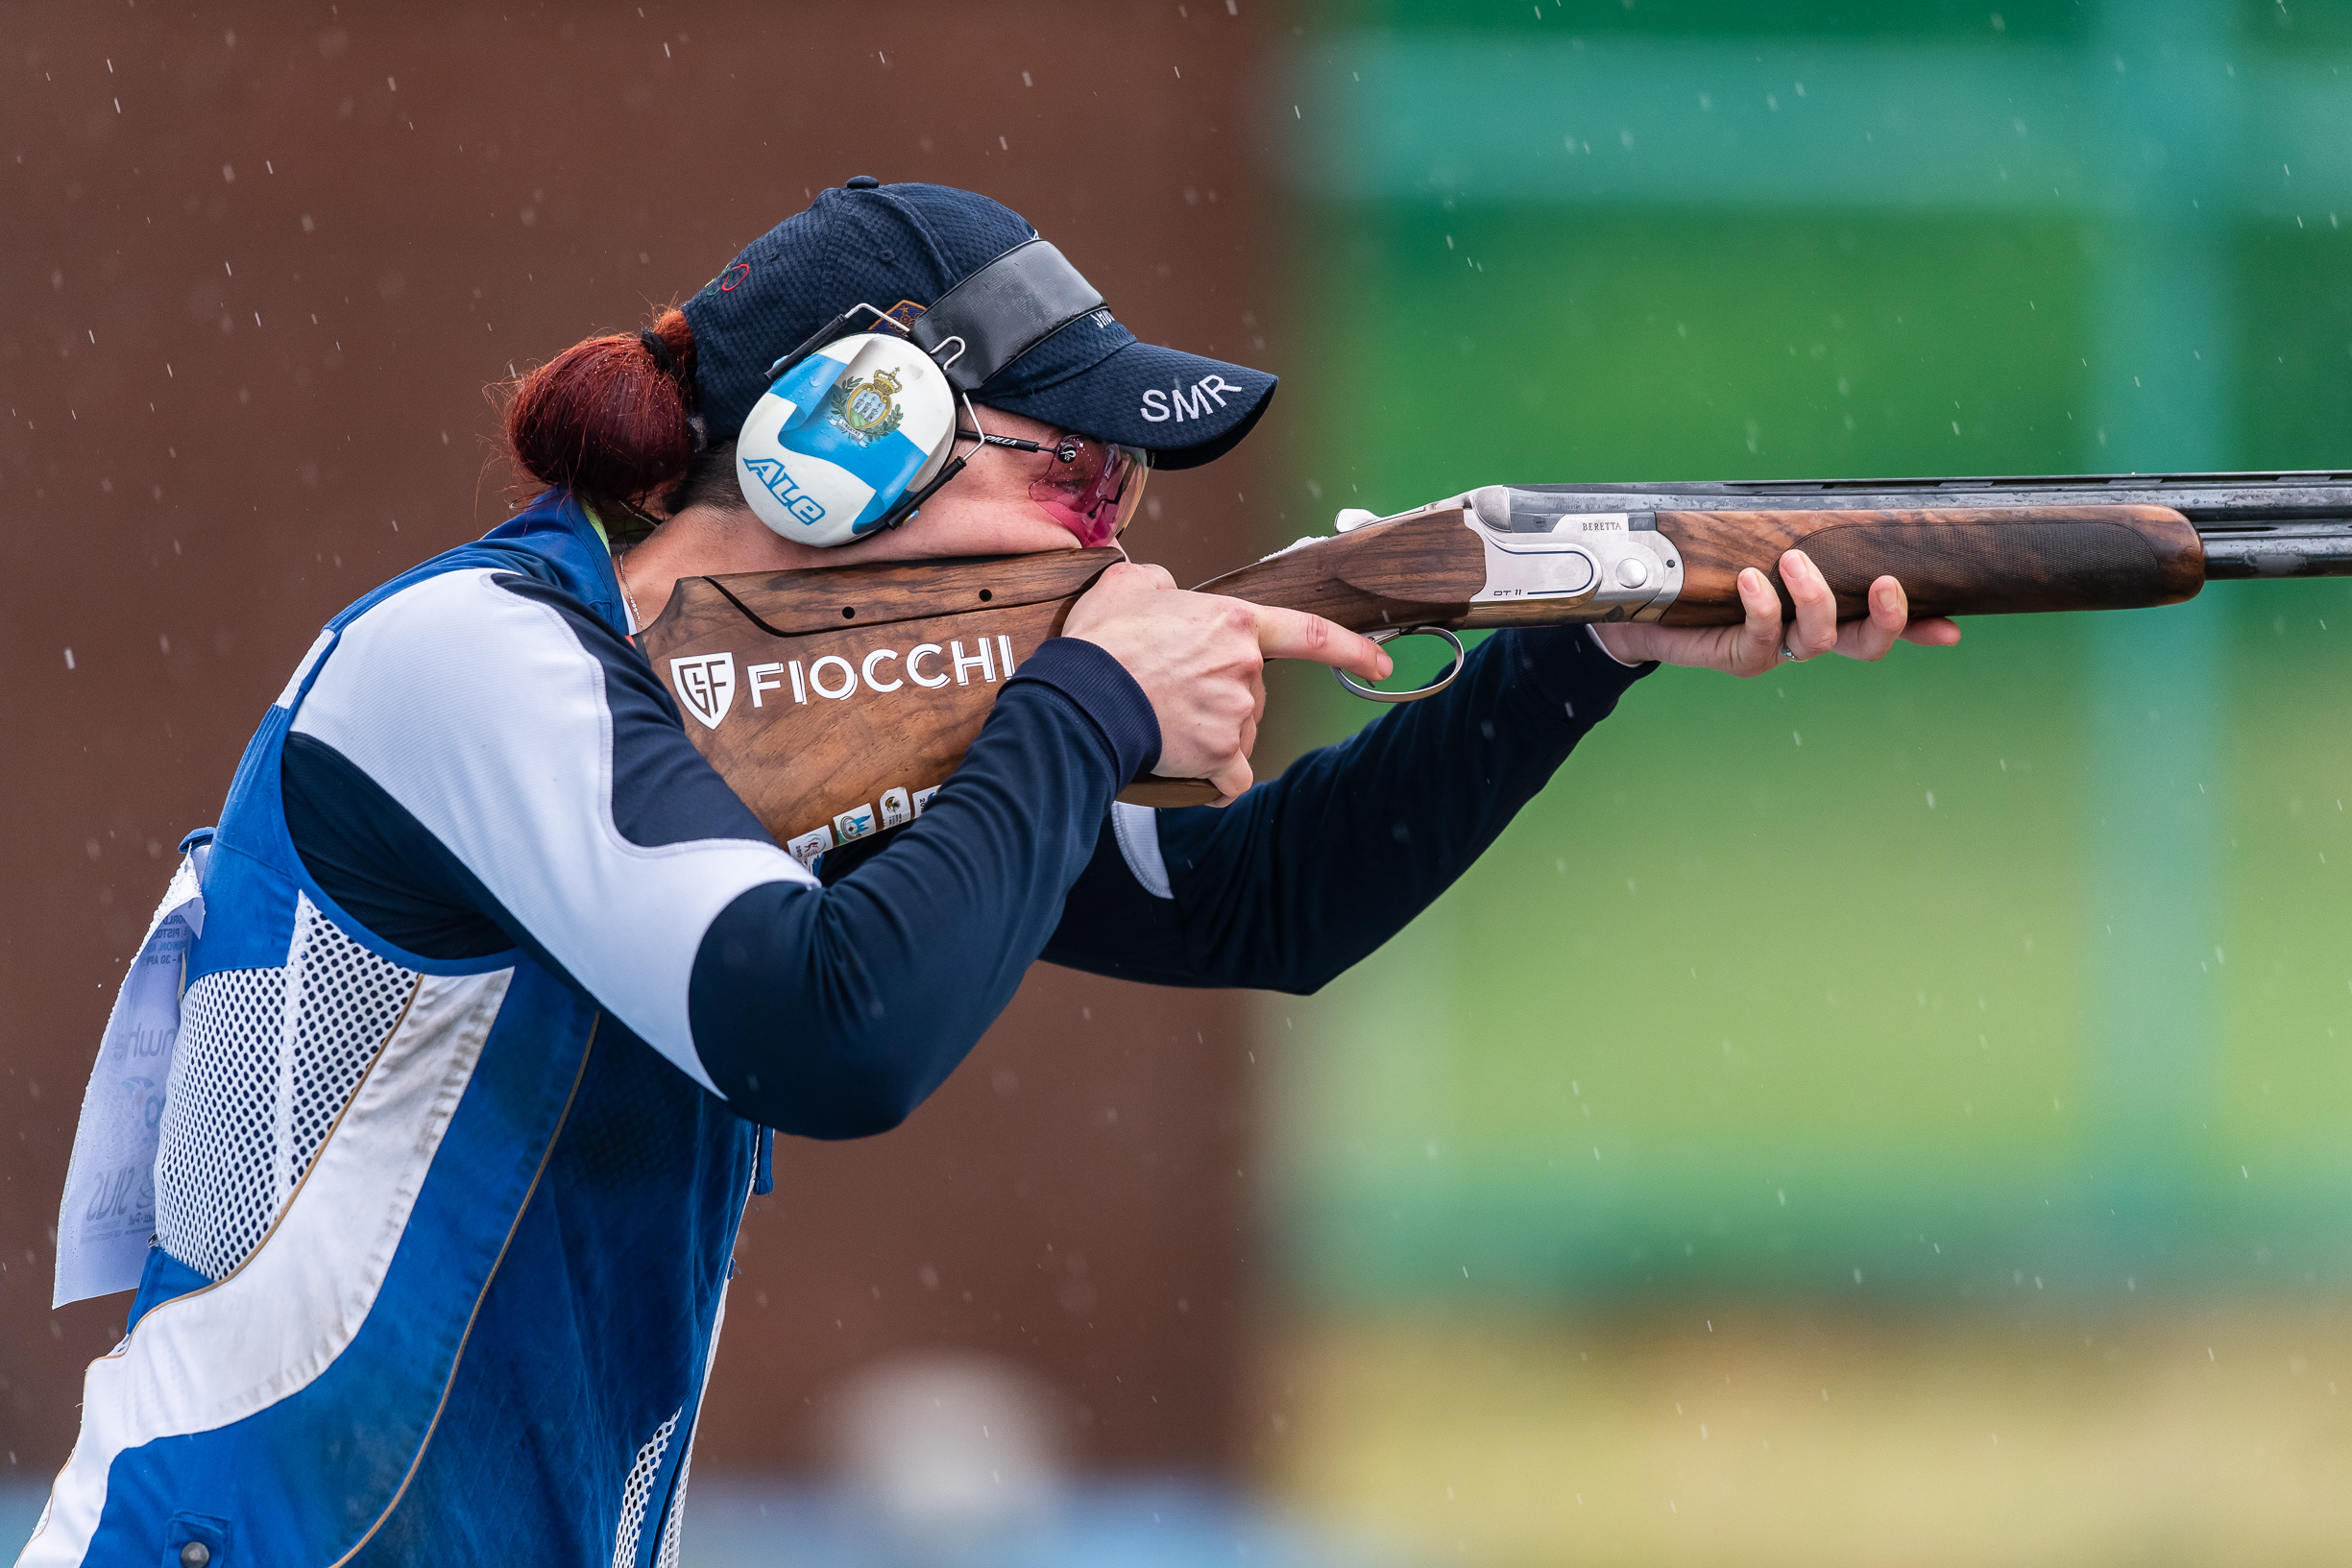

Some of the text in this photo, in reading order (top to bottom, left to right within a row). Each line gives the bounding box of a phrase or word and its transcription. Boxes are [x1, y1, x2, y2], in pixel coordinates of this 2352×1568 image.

[1140, 374, 1242, 422] SMR
[984, 435, 1018, 446] PILLA
[1582, 522, 1622, 532] BERETTA
[747, 634, 1016, 708] FIOCCHI
